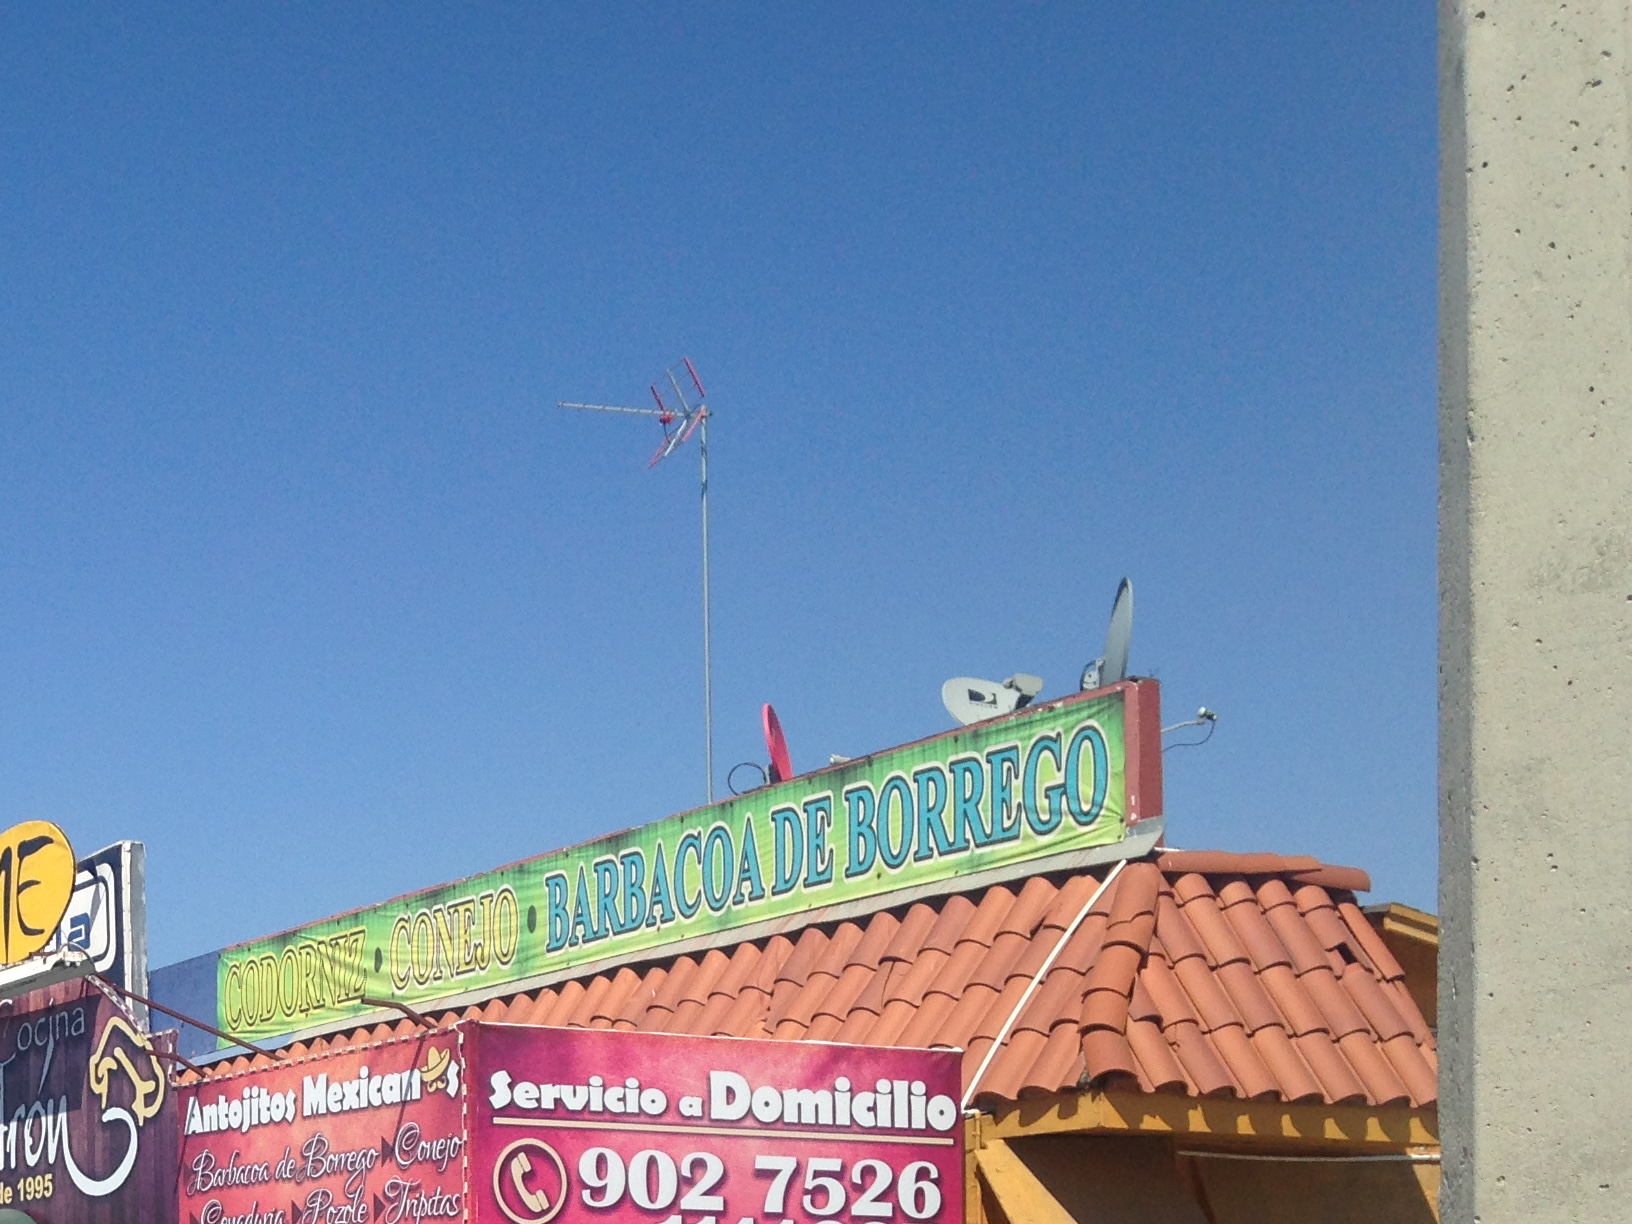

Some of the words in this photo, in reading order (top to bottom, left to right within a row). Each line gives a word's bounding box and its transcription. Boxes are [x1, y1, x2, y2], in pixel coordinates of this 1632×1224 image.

[224, 929, 367, 1031] CODORNIZ
[390, 887, 519, 990] CONEJO
[545, 816, 765, 953] BARBACOA
[771, 795, 834, 896] DE
[845, 724, 1108, 878] BORREGO
[184, 1086, 296, 1135] Antojitos
[489, 1071, 667, 1116] Servicio
[679, 1096, 704, 1118] a
[709, 1070, 957, 1131] Domicilio
[18, 1172, 53, 1203] 1995
[187, 1149, 269, 1196] Barbacoa
[275, 1147, 296, 1181] de
[296, 1133, 380, 1199] Borrego
[395, 1122, 463, 1172] Conejo
[578, 1147, 725, 1212] 902
[754, 1155, 942, 1219] 7526
